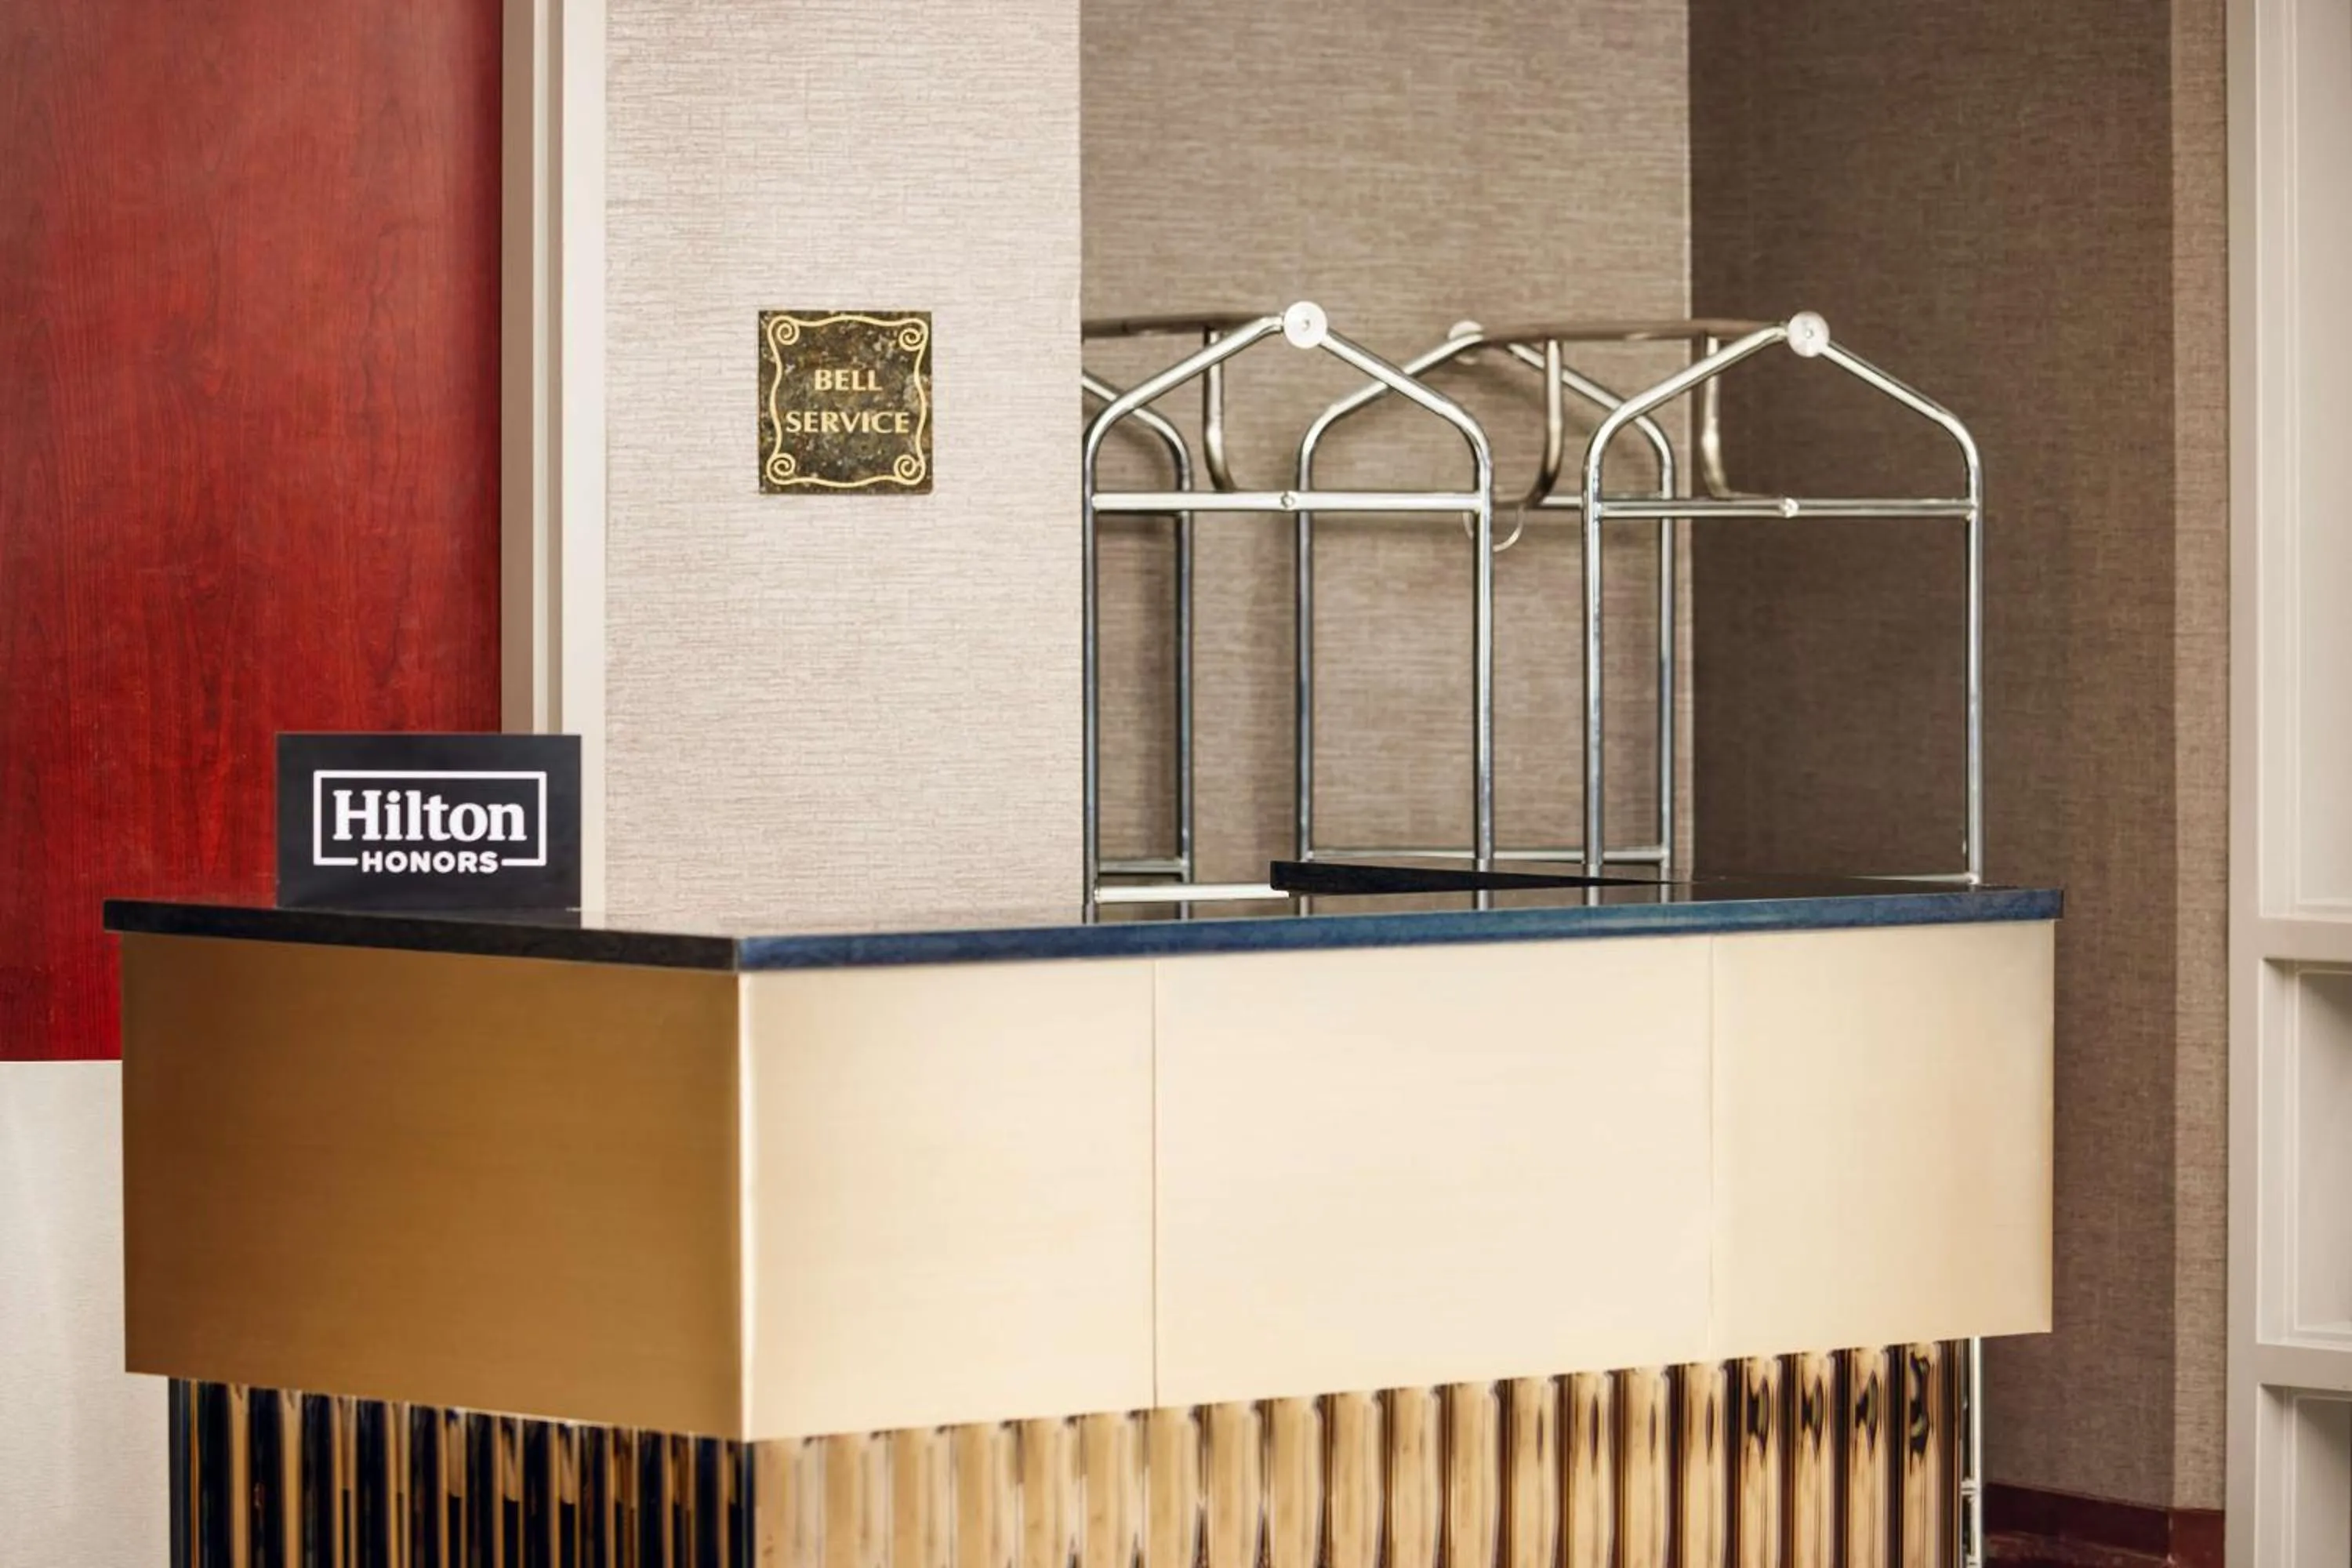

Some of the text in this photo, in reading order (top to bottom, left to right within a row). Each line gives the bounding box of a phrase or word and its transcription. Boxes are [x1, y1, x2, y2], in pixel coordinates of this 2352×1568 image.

[814, 369, 884, 391] BELL
[785, 410, 910, 434] SERVICE
[332, 789, 528, 842] Hilton
[361, 851, 499, 873] HONORS
